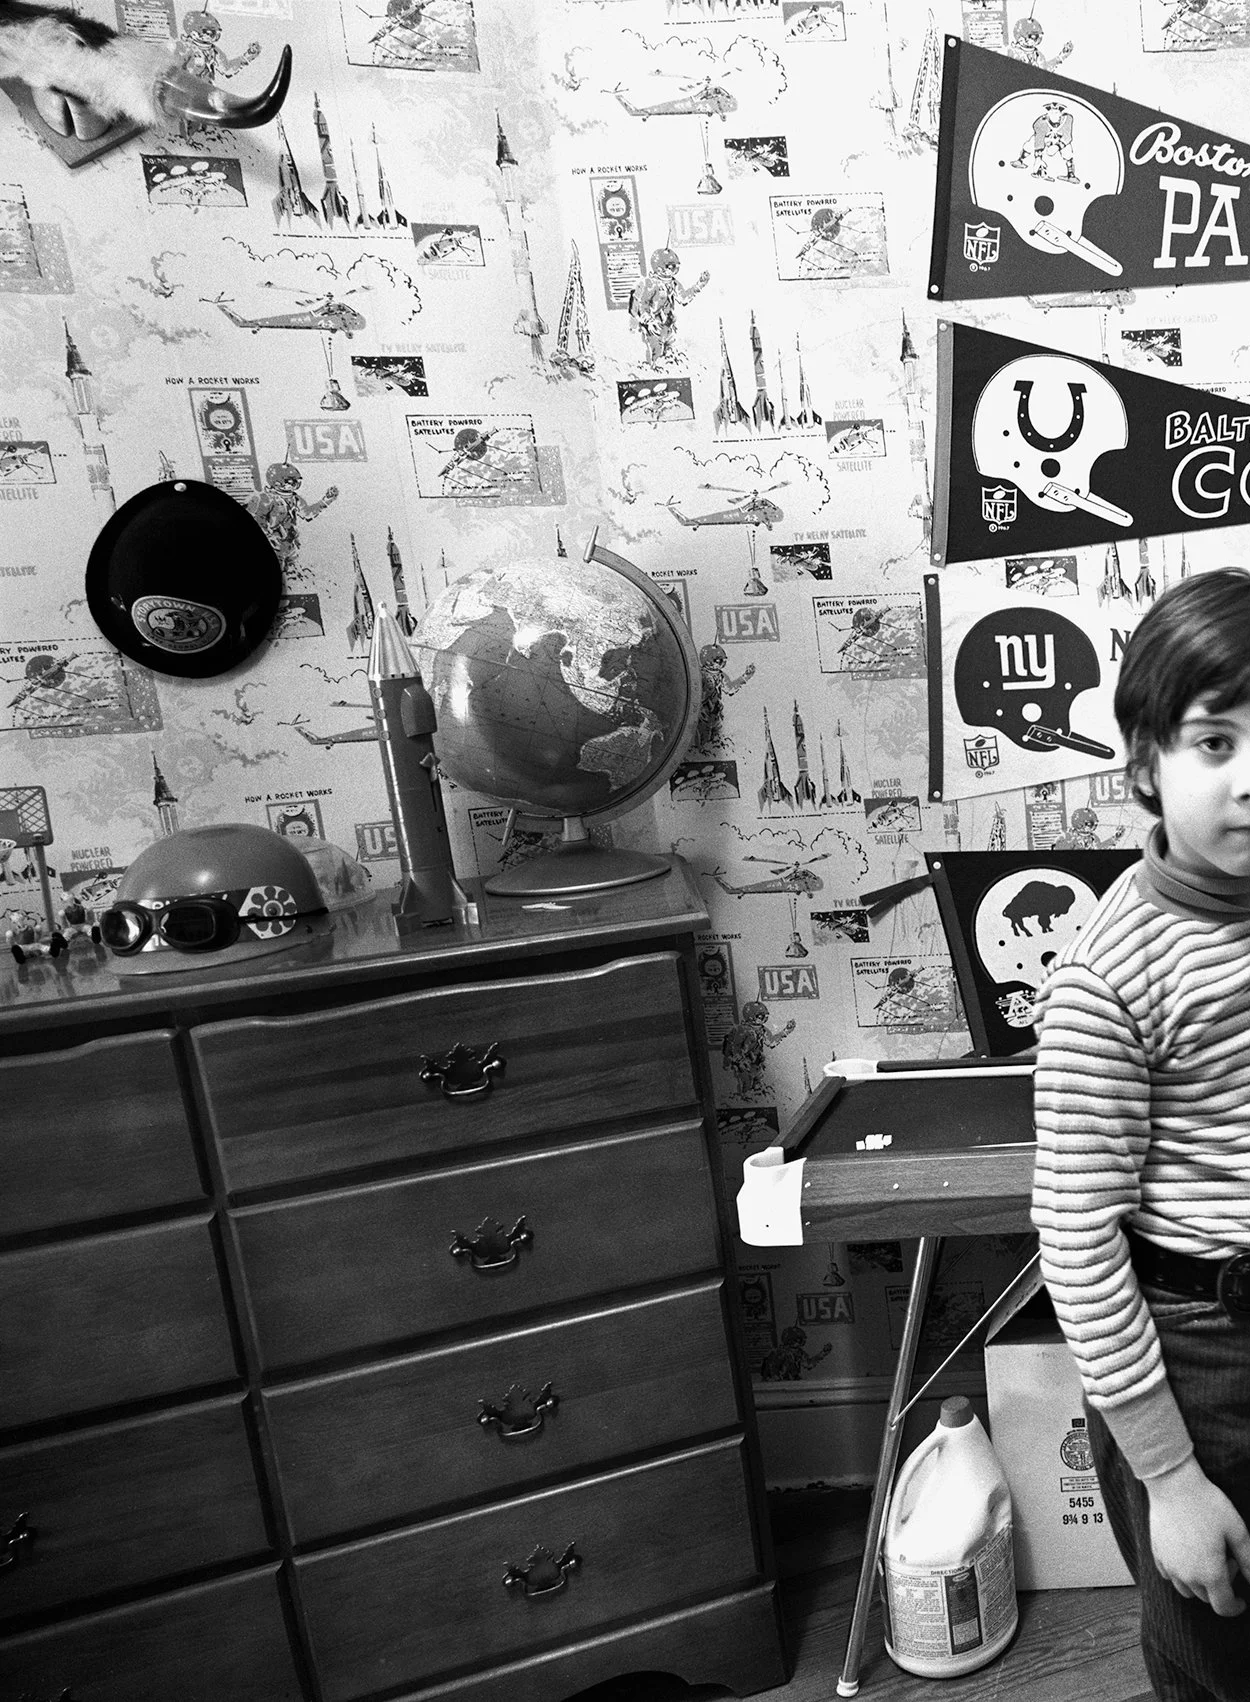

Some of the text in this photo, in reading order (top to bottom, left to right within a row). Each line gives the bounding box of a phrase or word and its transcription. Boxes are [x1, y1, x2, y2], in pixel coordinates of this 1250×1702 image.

[773, 200, 802, 209] BATTERY
[776, 208, 812, 217] SATELLITES
[674, 209, 731, 240] USA
[966, 240, 998, 261] NFL
[411, 418, 483, 427] BATTERY POWERED
[414, 428, 455, 436] SATELLITES
[293, 425, 359, 455] USA
[984, 502, 1015, 521] NFL
[651, 570, 674, 578] ROCKET
[816, 598, 877, 608] BATTERY POWERED
[137, 599, 196, 623] STORYTOWN
[819, 608, 853, 616] SATELLITES
[722, 609, 776, 637] USA
[17, 644, 58, 653] POWERED
[967, 749, 999, 768] NFL
[244, 788, 332, 803] HOW A ROCKET WORKS
[473, 811, 504, 819] BATTERY
[369, 828, 400, 855] US
[874, 833, 909, 845] SATELLITE
[71, 846, 110, 860] NUCLEAR
[70, 857, 113, 872] POWERED
[854, 959, 912, 969] BATTERY POWERED
[856, 967, 889, 975] SATELLITES
[765, 970, 811, 995] USA
[802, 1302, 846, 1320] USA
[1069, 1497, 1094, 1508] 5455
[1081, 1514, 1089, 1525] 9
[1093, 1512, 1104, 1524] 13
